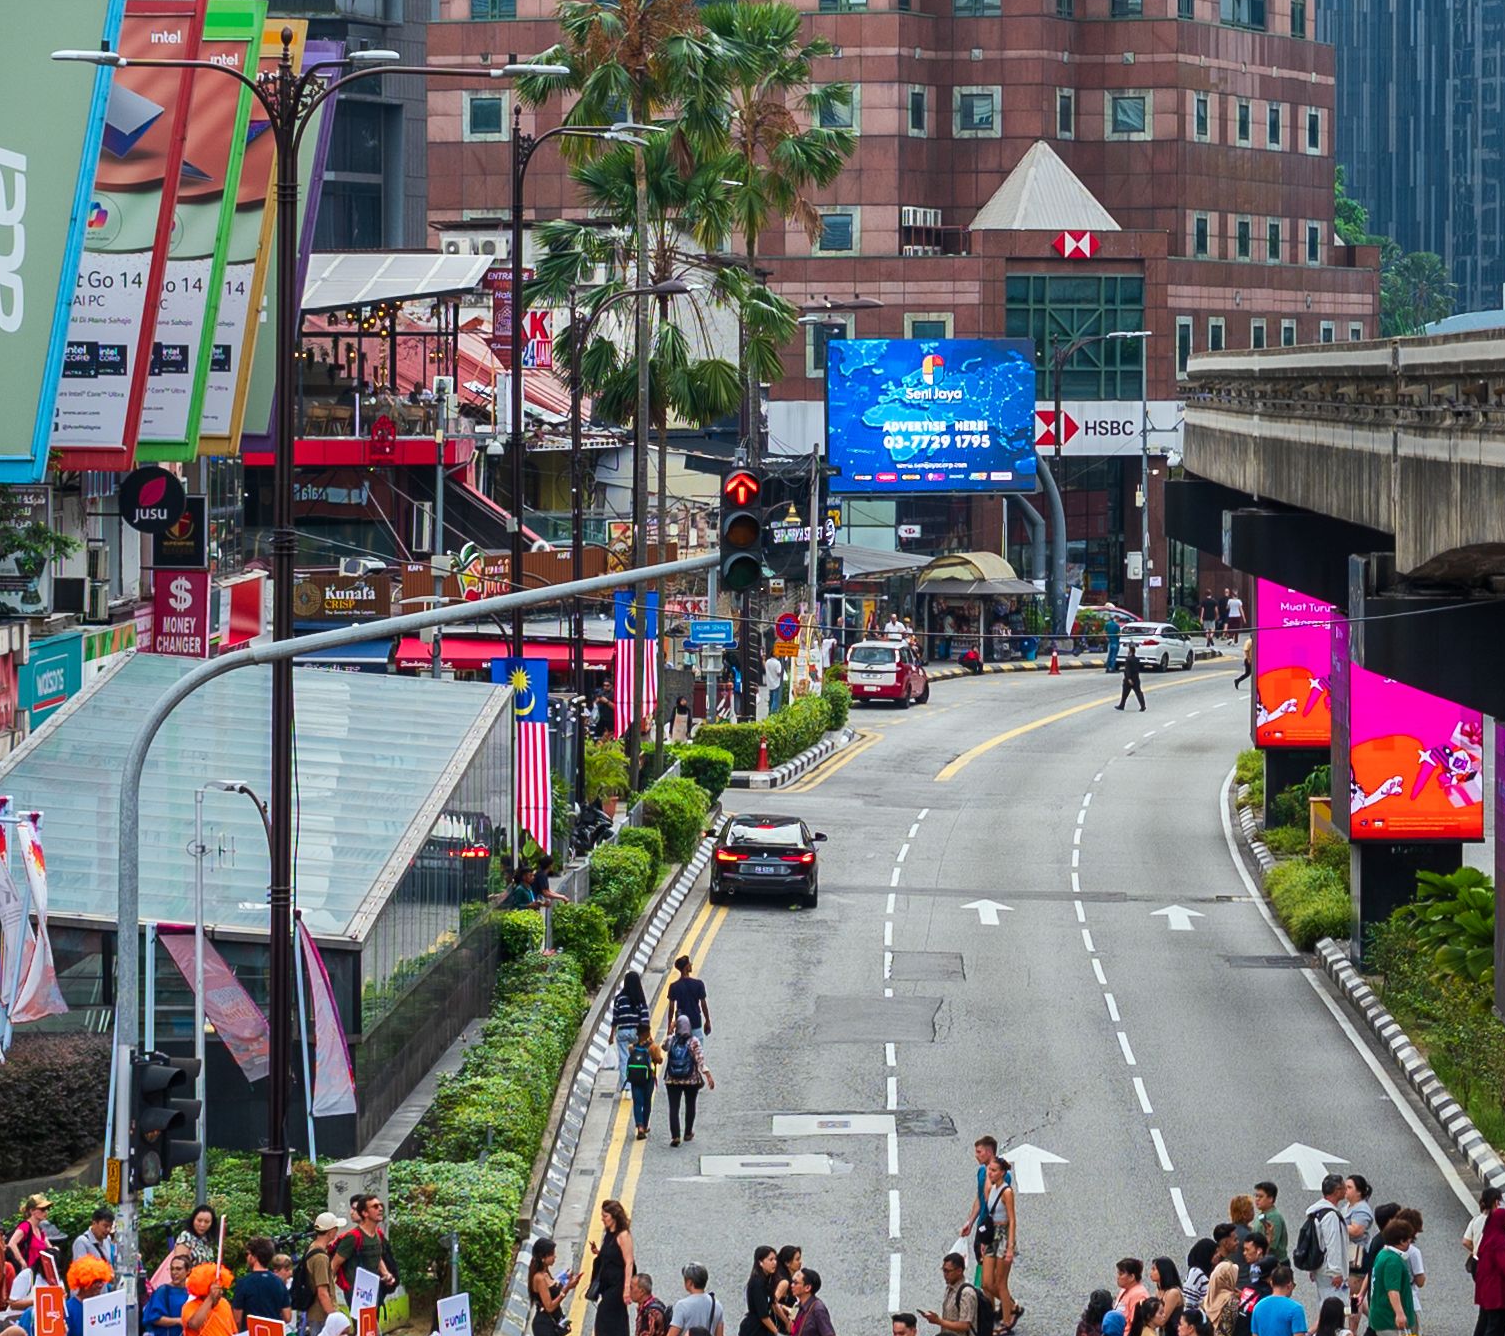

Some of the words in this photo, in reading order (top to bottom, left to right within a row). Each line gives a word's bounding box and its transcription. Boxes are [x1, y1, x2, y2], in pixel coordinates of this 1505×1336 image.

[151, 29, 182, 44] intel
[87, 270, 114, 288] Go
[120, 271, 142, 288] 14
[487, 271, 530, 281] ENTRACE
[182, 278, 203, 293] 14
[225, 281, 246, 296] 14
[72, 295, 86, 306] AI
[88, 295, 105, 307] PC
[99, 345, 118, 355] intel
[905, 388, 932, 400] Seni
[933, 387, 963, 403] Jaya
[882, 420, 947, 432] ADVERTISE
[1083, 418, 1134, 437] HSBC
[883, 434, 951, 449] 03-7729
[954, 434, 991, 449] 1795
[168, 575, 193, 613] $
[324, 599, 356, 609] CRISP
[1280, 602, 1307, 612] Muat
[162, 617, 196, 634] MONEY
[156, 636, 201, 653] CHANGER
[36, 668, 64, 697] watsons
[97, 1305, 121, 1323] unifi
